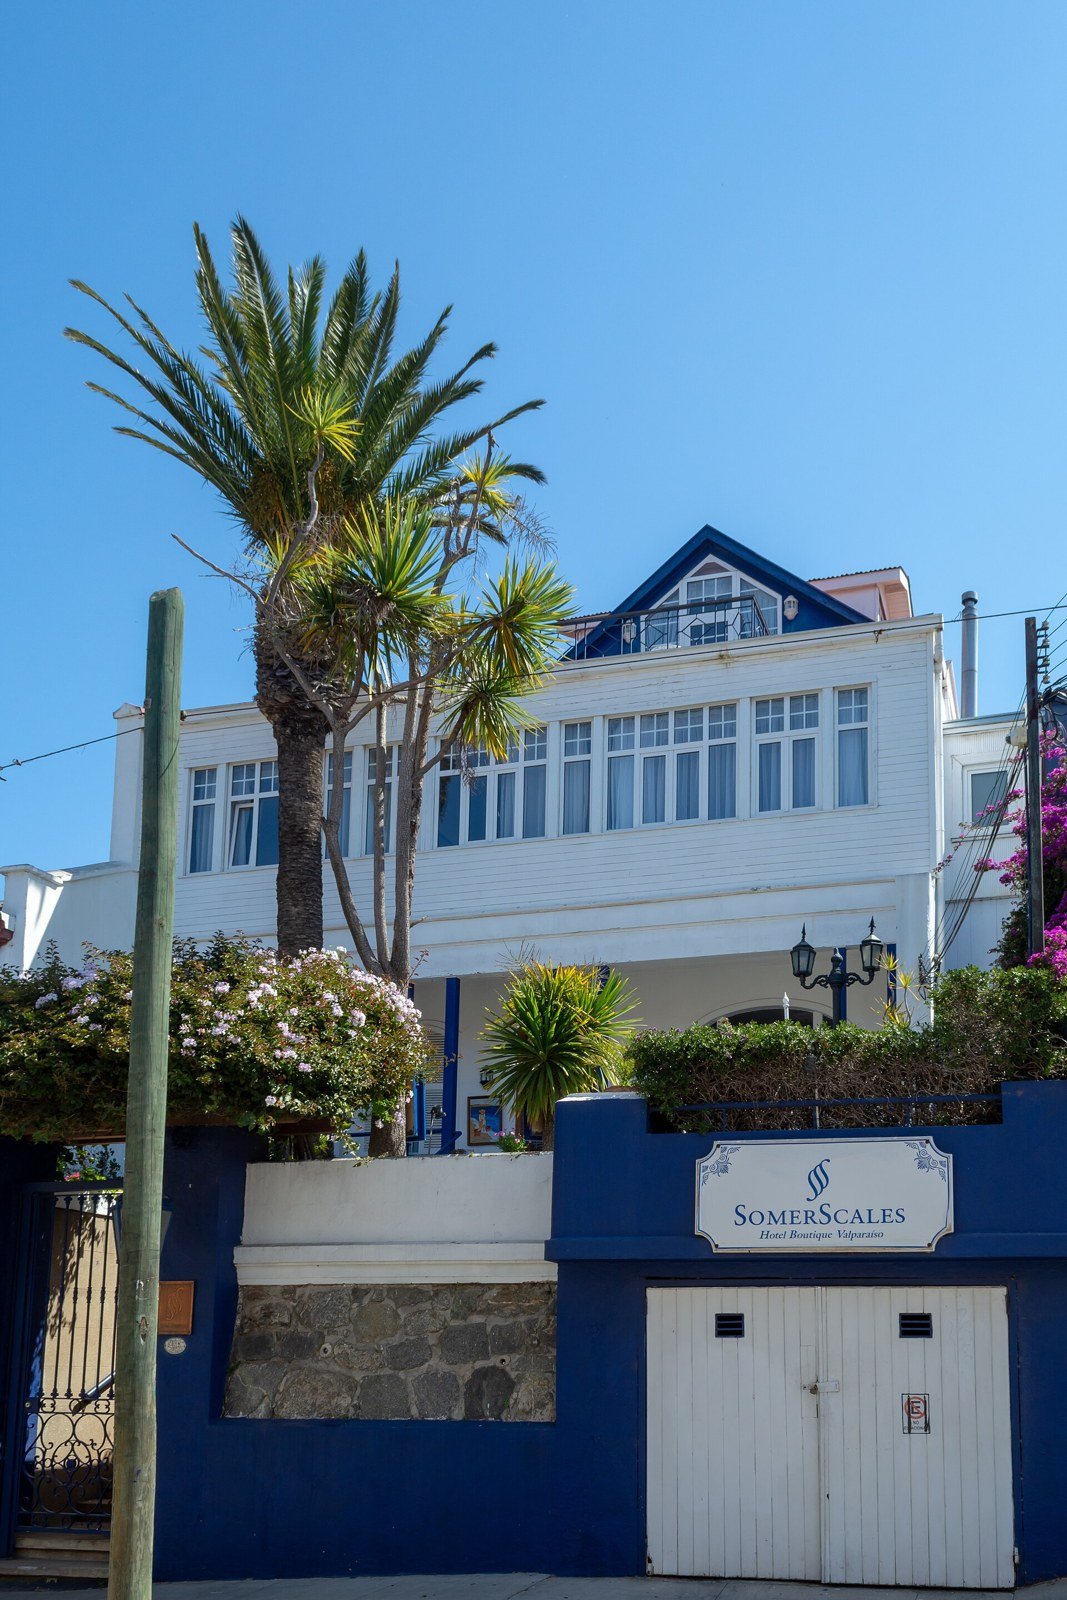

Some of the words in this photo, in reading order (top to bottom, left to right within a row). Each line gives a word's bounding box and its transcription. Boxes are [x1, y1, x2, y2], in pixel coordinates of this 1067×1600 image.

[759, 1230, 787, 1240] Hotel
[789, 1229, 833, 1241] Boutique
[837, 1229, 884, 1241] Valparaíso
